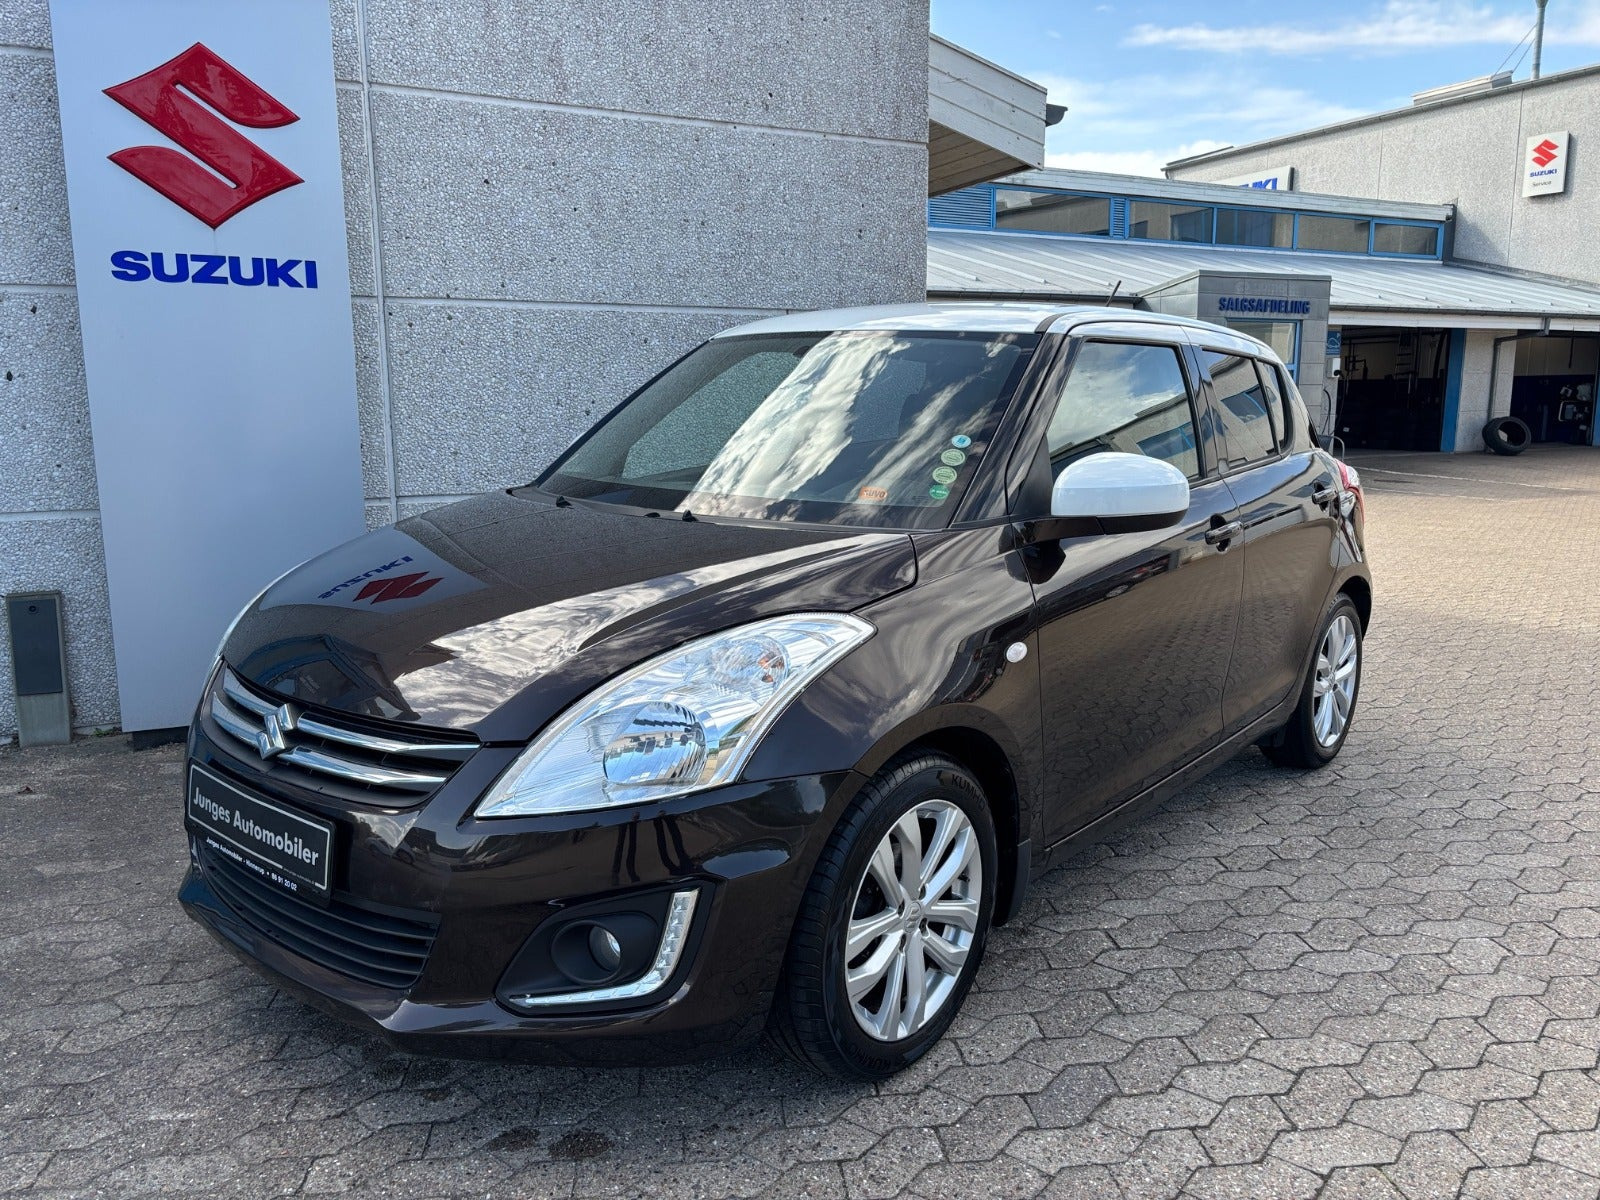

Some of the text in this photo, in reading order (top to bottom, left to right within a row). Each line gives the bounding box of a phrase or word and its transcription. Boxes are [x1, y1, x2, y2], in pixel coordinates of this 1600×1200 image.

[1529, 168, 1558, 178] SUZUKI
[110, 250, 319, 289] SUZUKI
[1218, 296, 1311, 314] SALGSAFDELING
[193, 787, 319, 866] Junges Automobiler
[206, 836, 220, 849] Junges
[220, 844, 243, 863] Automobiler
